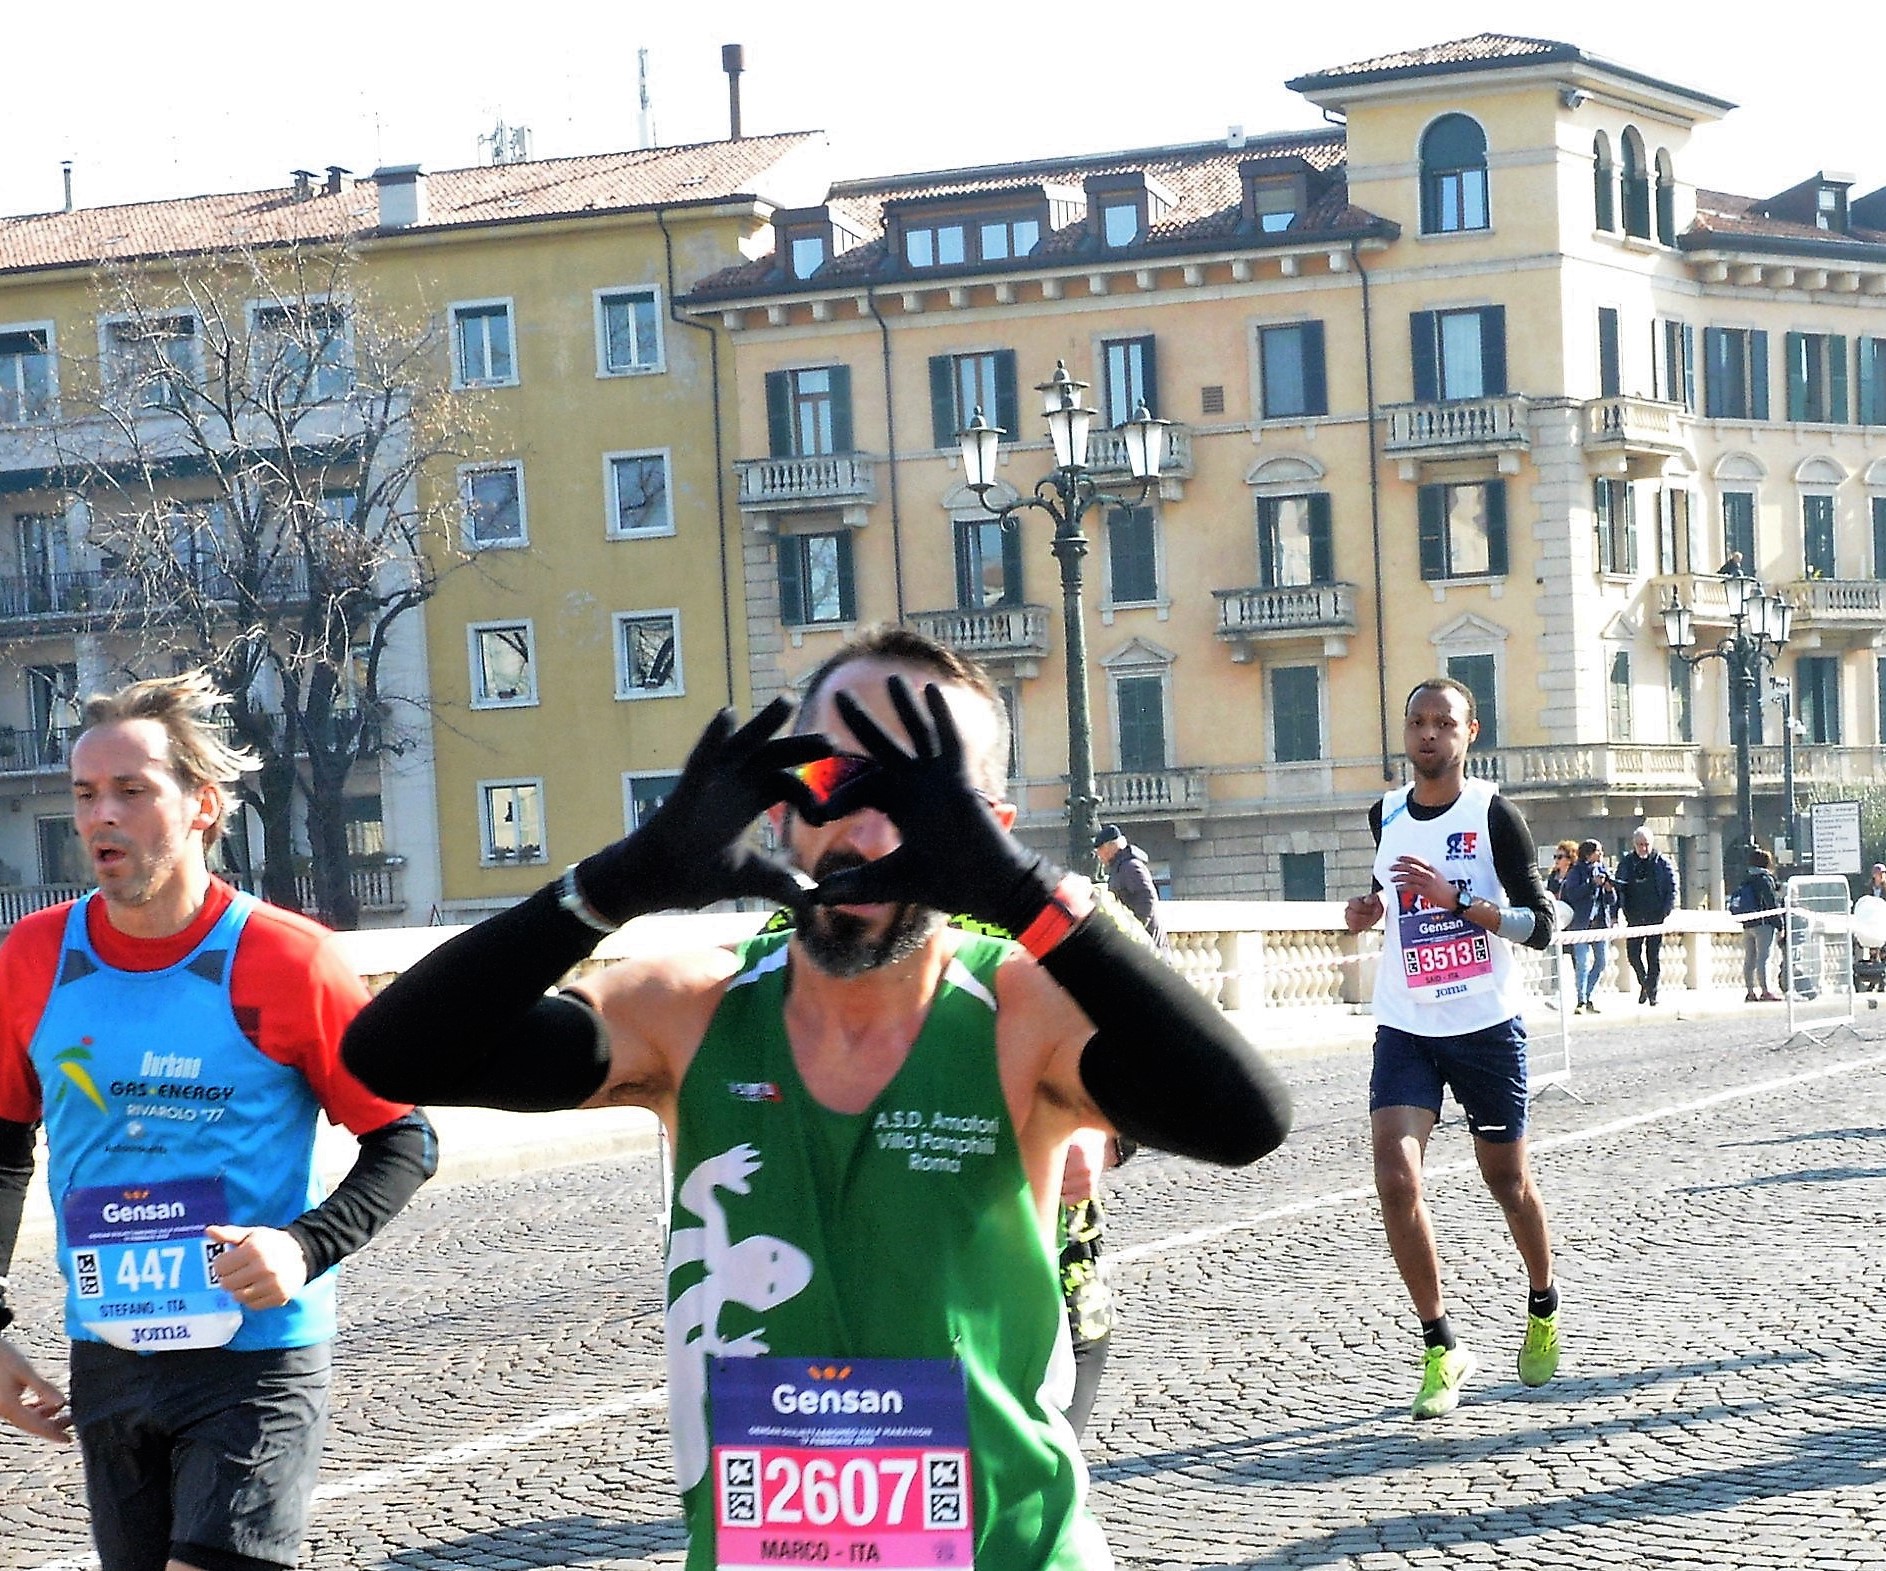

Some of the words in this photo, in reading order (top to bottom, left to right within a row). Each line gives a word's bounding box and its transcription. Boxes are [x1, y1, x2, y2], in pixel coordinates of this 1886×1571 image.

[1419, 920, 1464, 934] Gensan
[1420, 942, 1472, 972] 3513
[110, 1081, 147, 1097] GAS
[158, 1083, 235, 1101] ENERGY
[873, 1110, 927, 1129] A.S.D.
[102, 1199, 185, 1223] Gensan
[116, 1247, 185, 1293] 447
[100, 1302, 155, 1318] STEFANO
[167, 1299, 187, 1313] ITA
[772, 1383, 903, 1414] Gensan
[765, 1456, 918, 1526] 2607
[761, 1540, 830, 1560] MARCO
[850, 1544, 880, 1562] ITA
